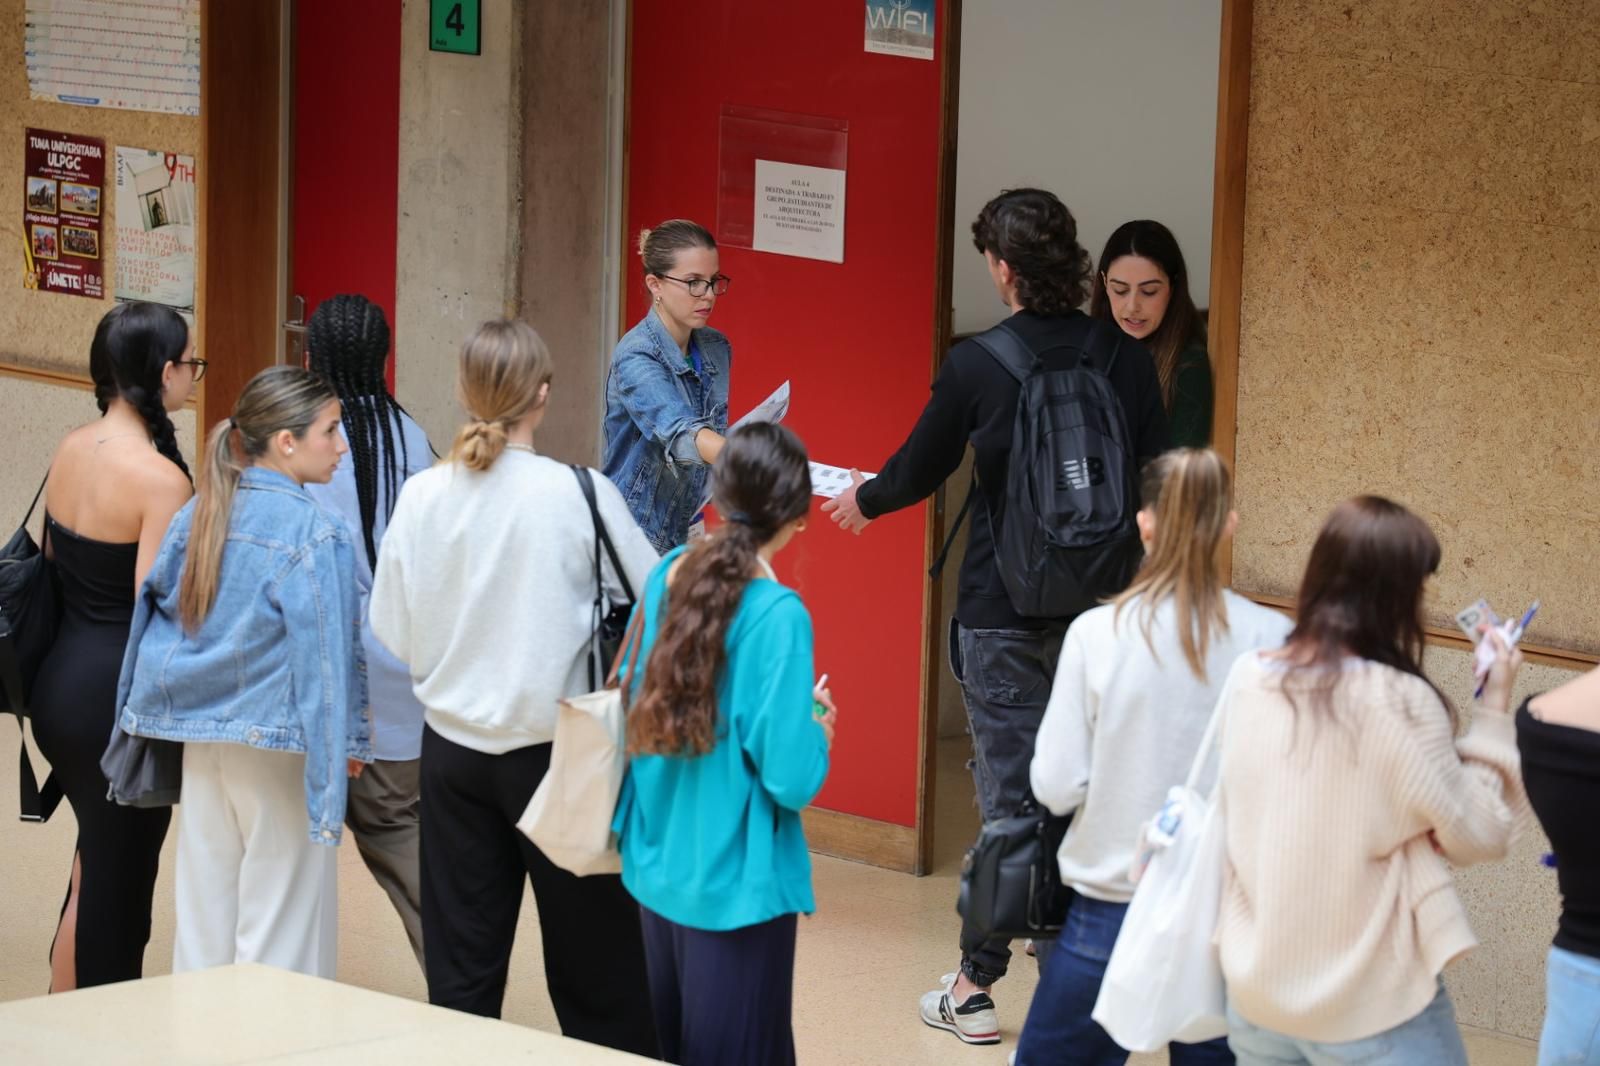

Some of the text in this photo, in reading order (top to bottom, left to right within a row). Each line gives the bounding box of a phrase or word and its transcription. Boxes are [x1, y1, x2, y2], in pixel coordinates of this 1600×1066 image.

[445, 3, 464, 36] 4
[30, 136, 102, 159] TUNA UNIVERSITARIA
[48, 152, 81, 171] ULPGC
